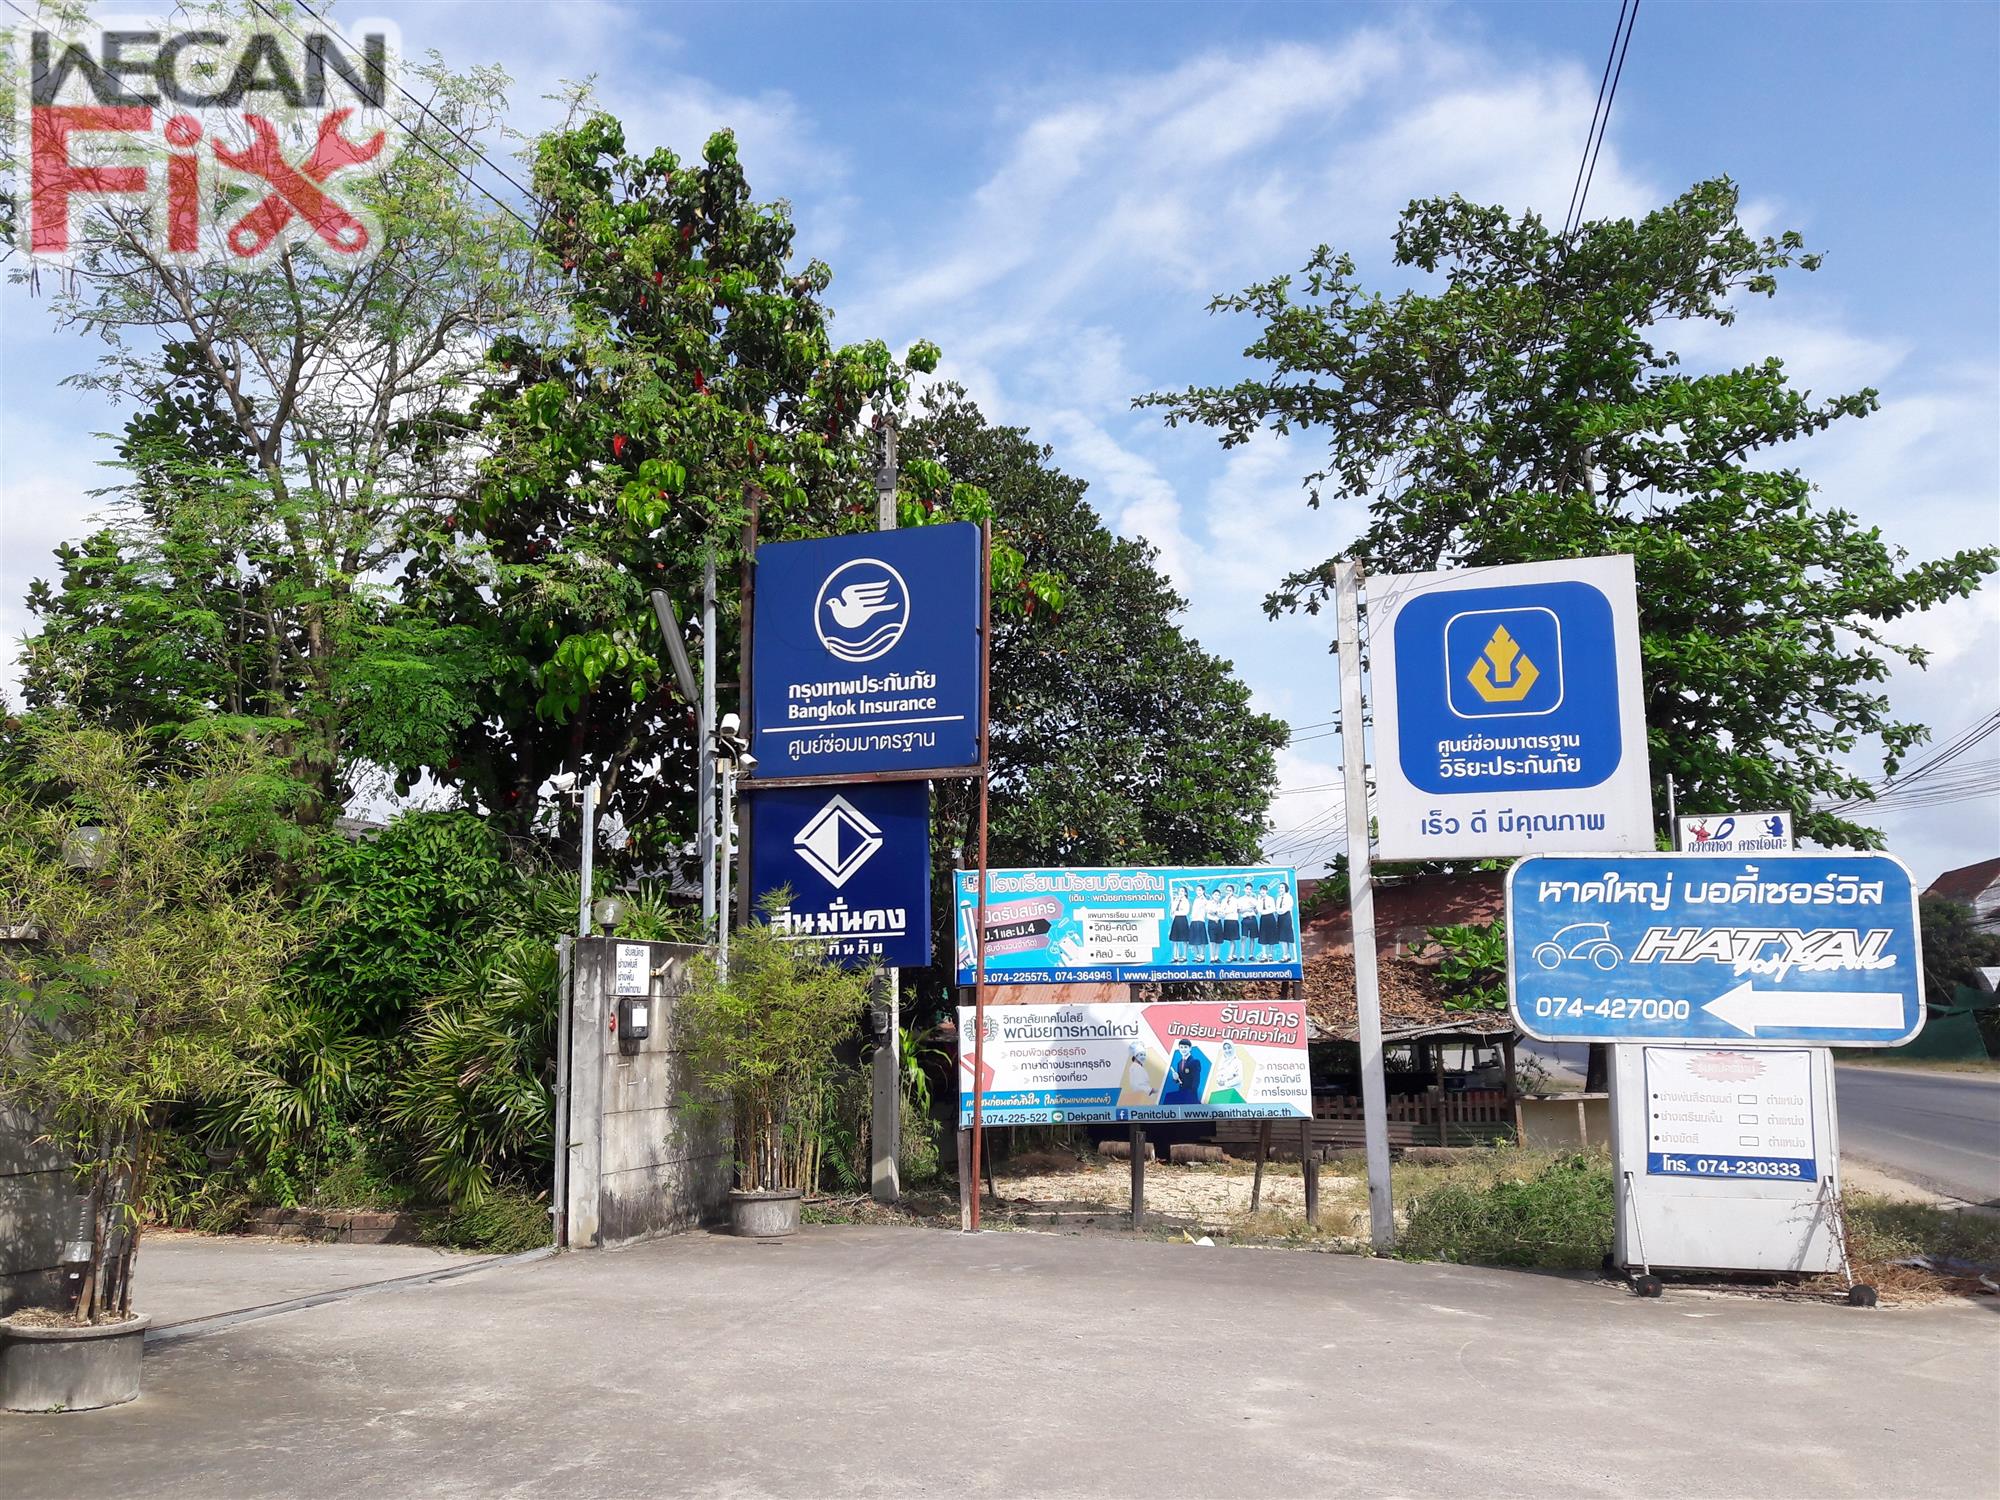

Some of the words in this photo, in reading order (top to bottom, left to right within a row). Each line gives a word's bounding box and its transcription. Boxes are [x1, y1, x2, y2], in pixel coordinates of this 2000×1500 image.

[788, 670, 937, 703] กรุงเทพประกันภัย
[788, 699, 857, 722] Bangkok
[860, 695, 937, 714] Insurance
[788, 732, 936, 761] ศูนย์ซ่อมมาตรฐาน
[1438, 733, 1580, 757] ศูนย์ซ่อมมาตรฐาน
[1439, 753, 1581, 778] วิริยะประกันภัย
[1421, 809, 1460, 836] เร็ว
[1470, 808, 1488, 834] ดี
[1498, 808, 1605, 840] มีคุณภาพ
[1538, 872, 1674, 912] หาดใหญ่
[1684, 864, 1884, 906] บอดี้เซอร์วิส
[1055, 970, 1112, 982] 074-364948
[1123, 969, 1216, 982] www.jjschool.ac.th
[1003, 1011, 1084, 1025] วิทยาลัยเทคโนโลยี
[1219, 1003, 1300, 1029] รับสมัคร
[1535, 996, 1690, 1020] 074-427000
[1003, 1020, 1139, 1039] พณิชยการหาดใหญ่
[1167, 1020, 1297, 1045] นักเรียน-นักศึกษาใหม่
[1067, 1111, 1111, 1122] Dekpanit
[1130, 1109, 1177, 1120] Panitclub
[1184, 1107, 1292, 1120] www.panithatyai.ac.th
[1662, 1154, 1691, 1173] โทร.
[1697, 1159, 1801, 1177] 074-230333
